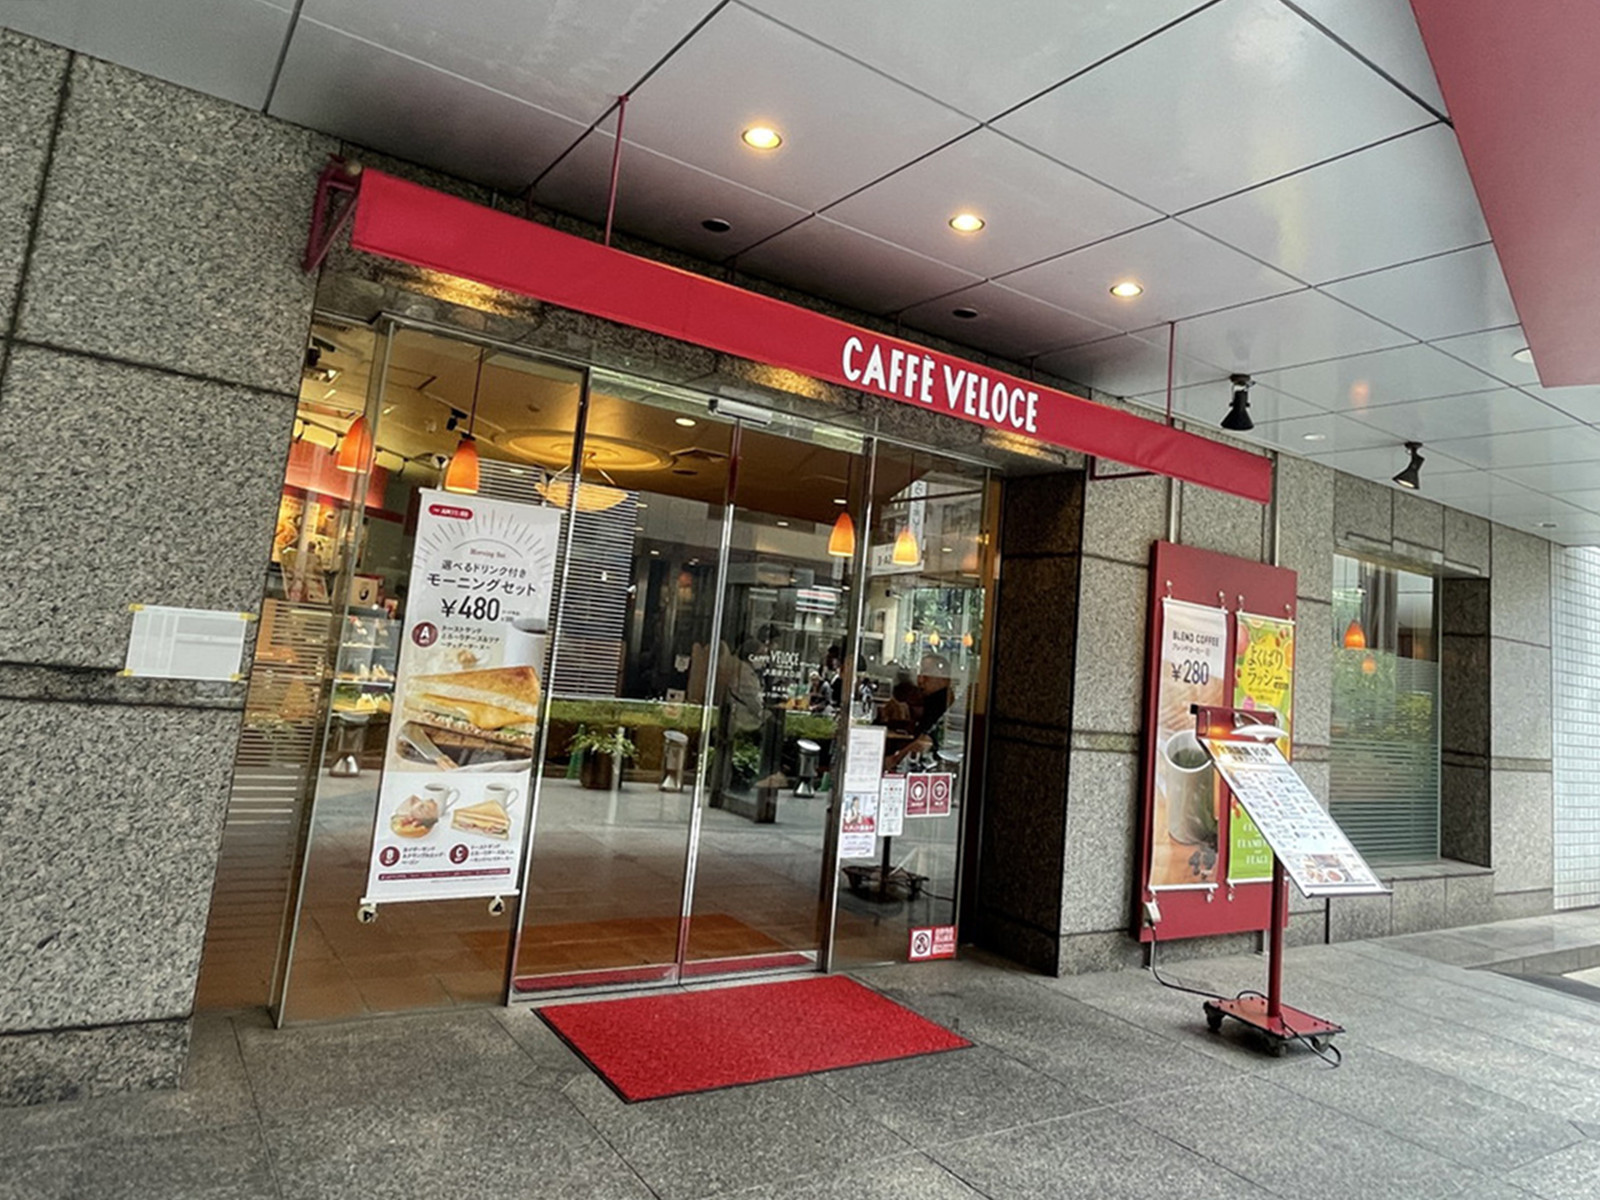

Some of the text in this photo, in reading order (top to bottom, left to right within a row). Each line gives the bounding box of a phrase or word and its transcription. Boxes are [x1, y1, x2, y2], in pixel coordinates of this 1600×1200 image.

[842, 337, 1039, 433] CAFFÈ VELOCE
[441, 559, 527, 578] 選べるドリンク付き
[427, 573, 536, 597] モーニングセット
[441, 595, 500, 621] ¥480
[420, 625, 430, 639] A
[1172, 630, 1219, 647] BLEND COFFEE
[1247, 646, 1283, 670] よくばり
[1171, 659, 1209, 685] ¥280
[1247, 668, 1284, 686] ラッシー
